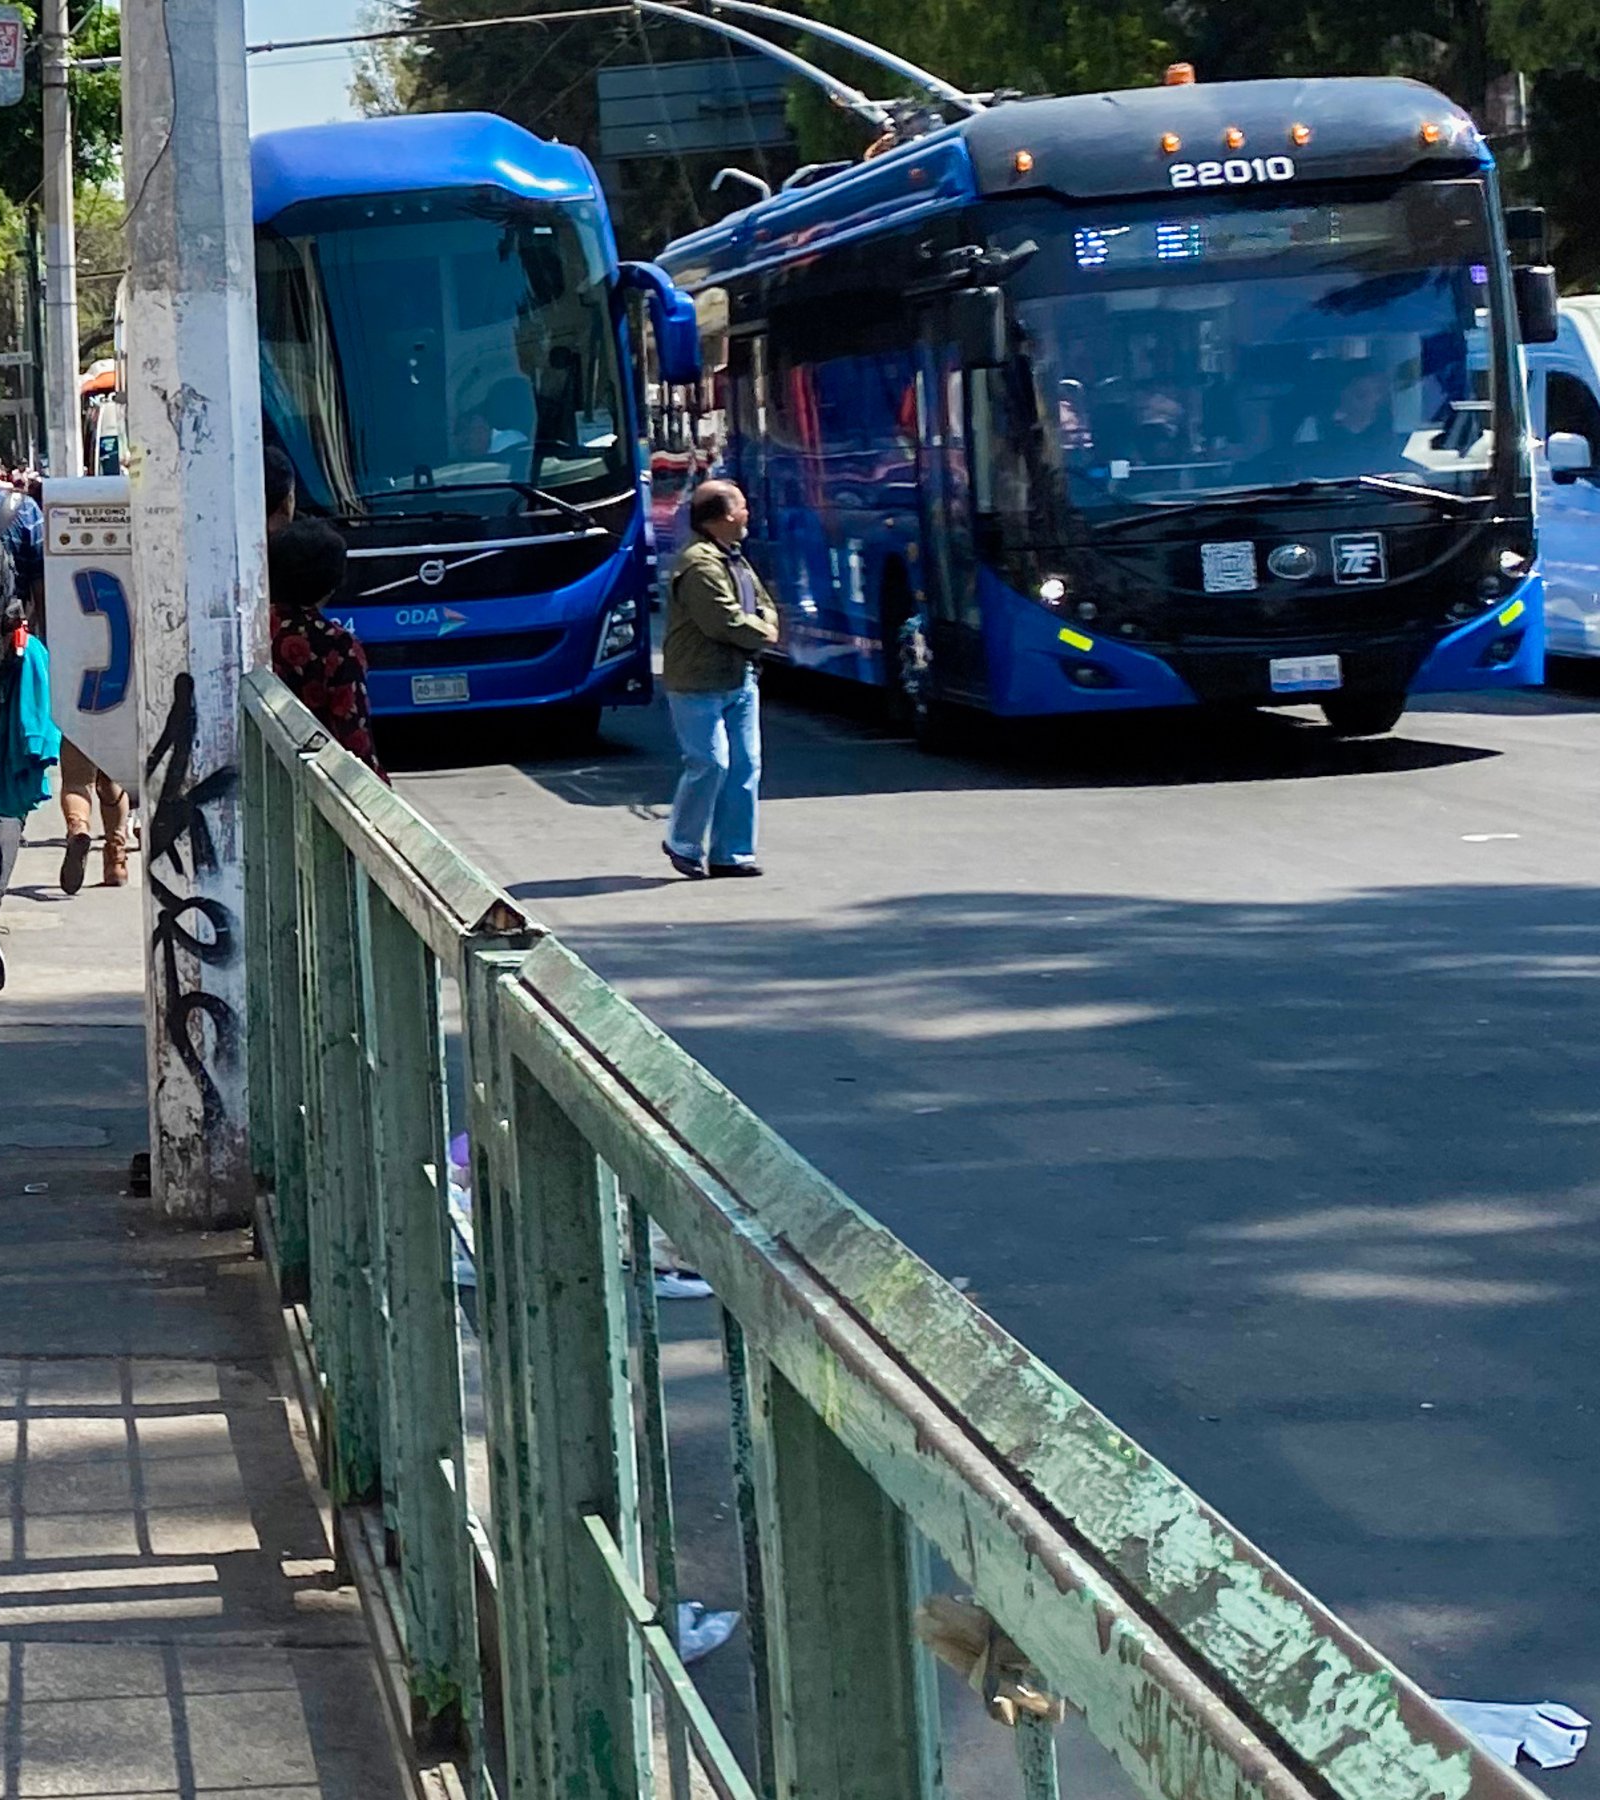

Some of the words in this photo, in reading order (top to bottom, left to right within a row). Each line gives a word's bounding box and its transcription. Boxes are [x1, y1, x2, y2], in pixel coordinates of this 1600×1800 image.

[1169, 156, 1295, 188] 22010
[69, 516, 81, 524] DE
[395, 607, 440, 625] ODA
